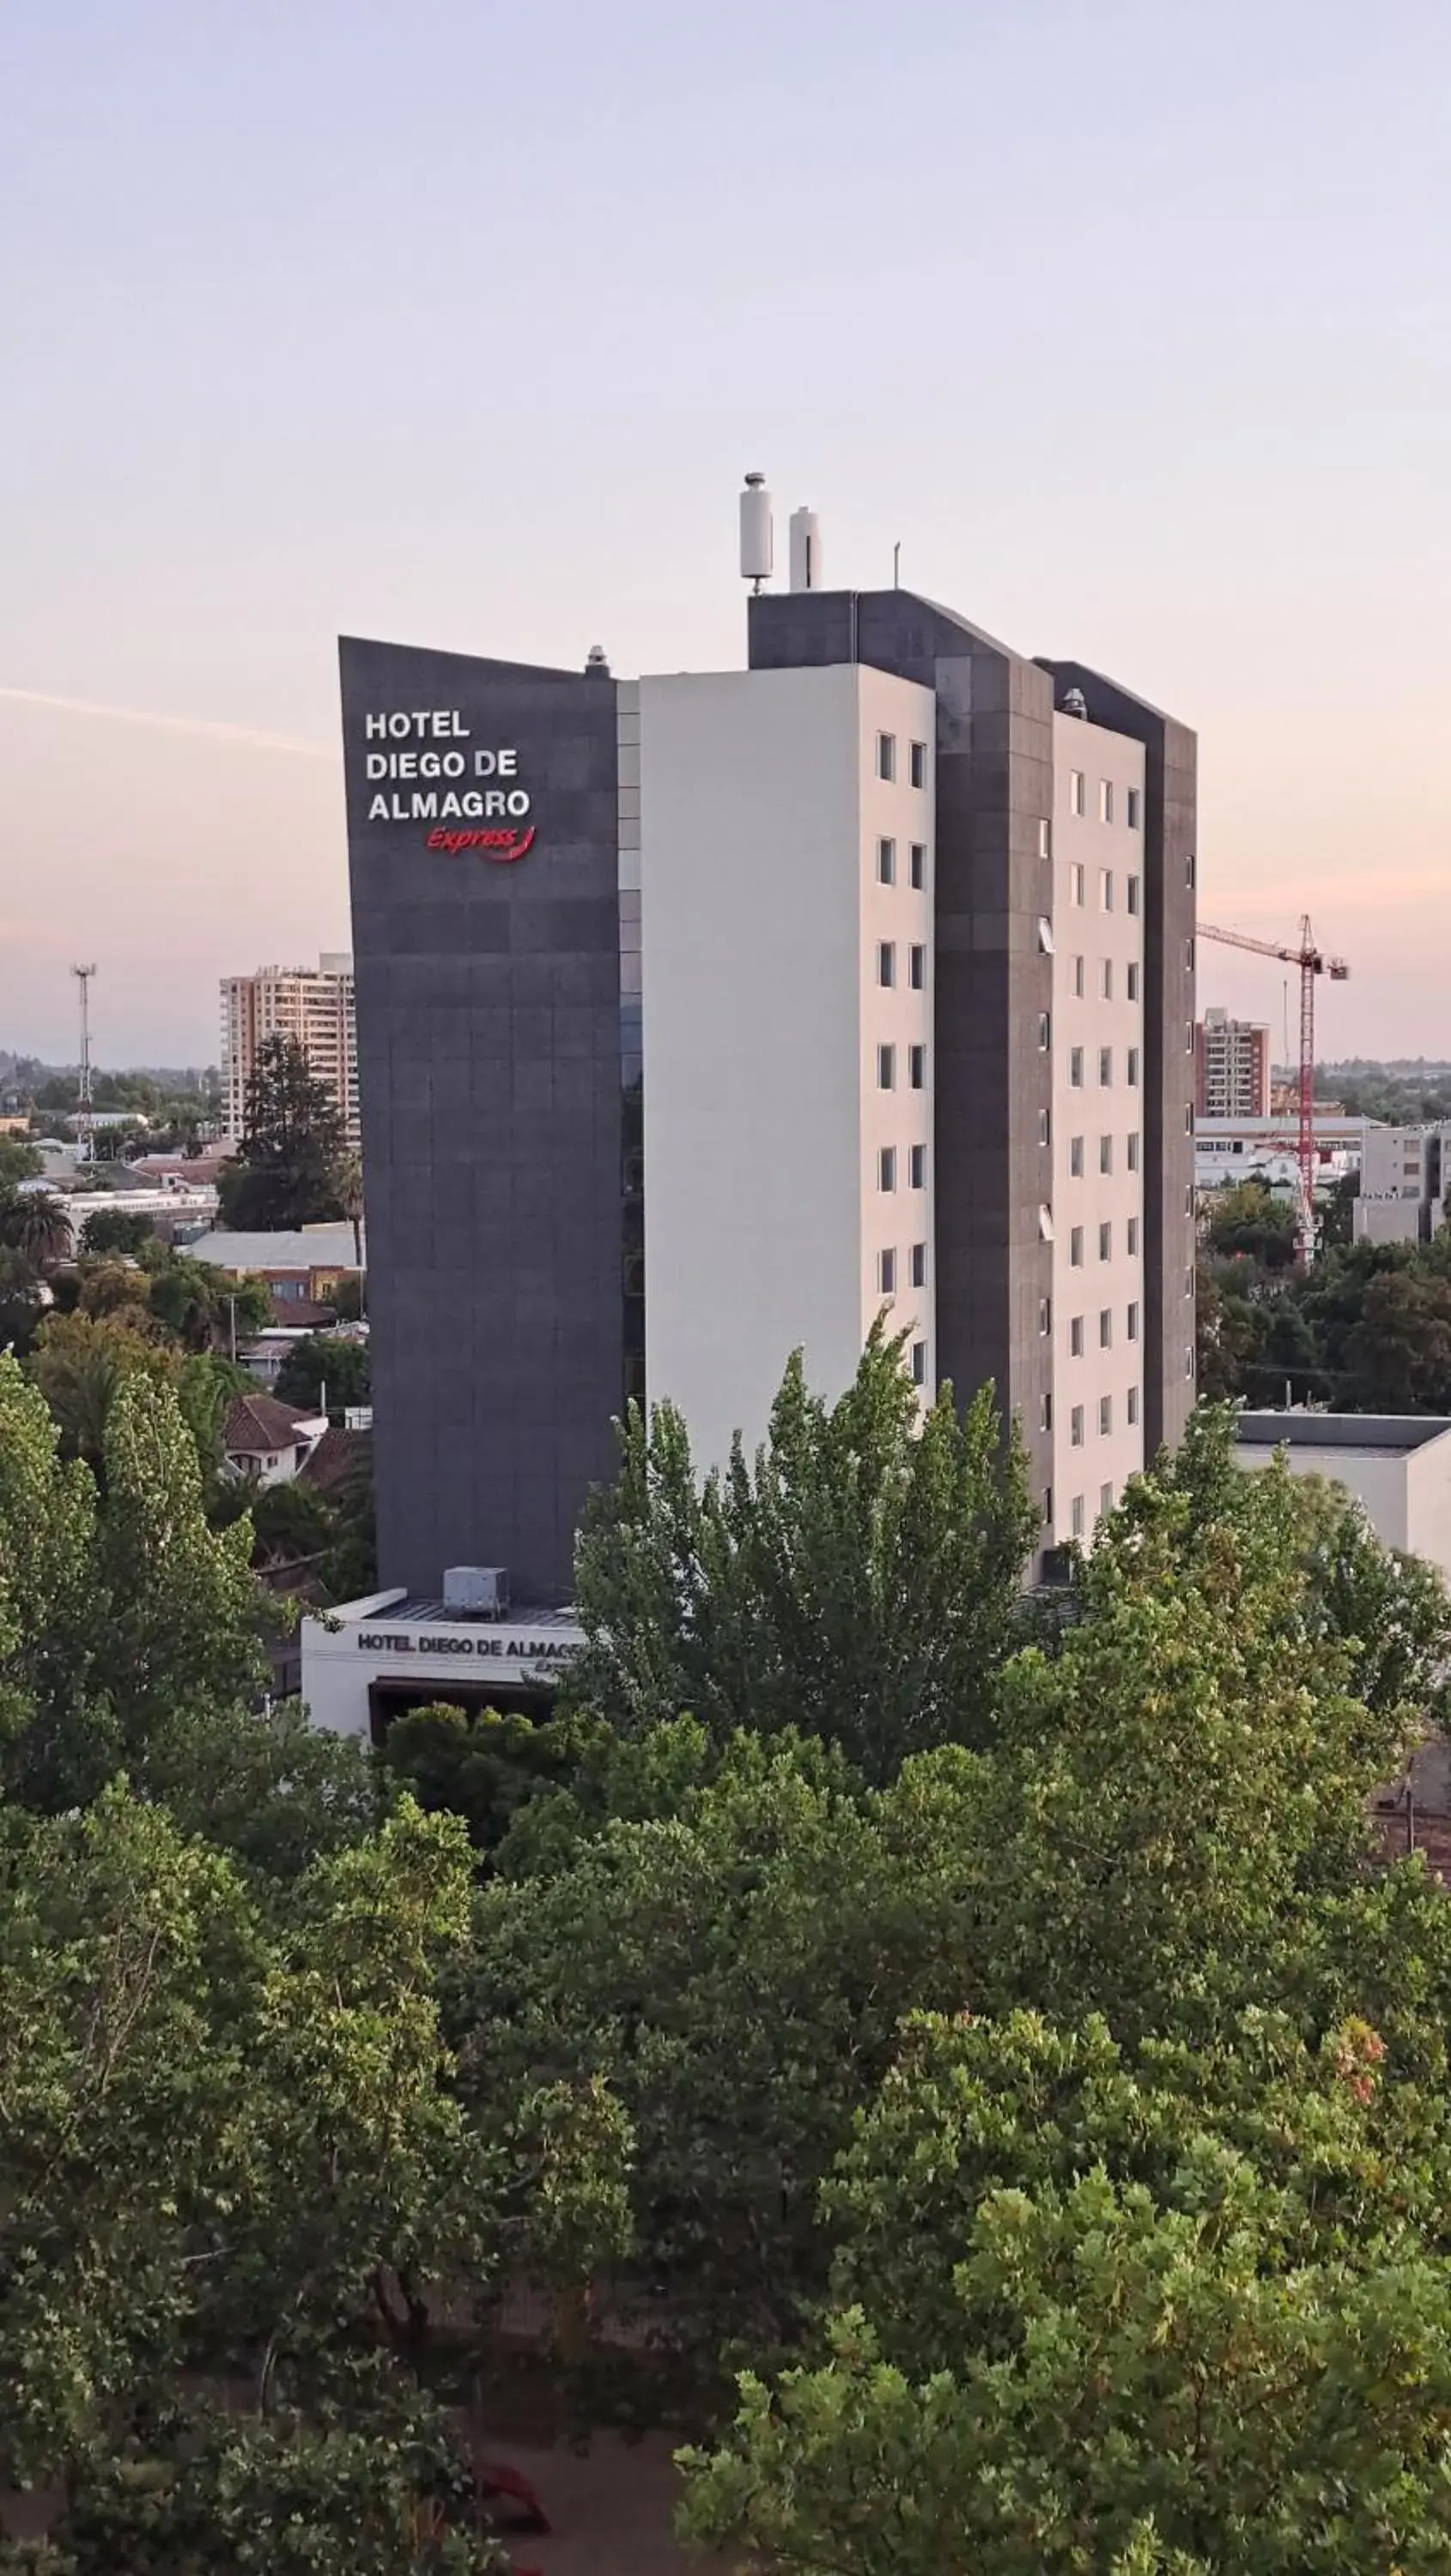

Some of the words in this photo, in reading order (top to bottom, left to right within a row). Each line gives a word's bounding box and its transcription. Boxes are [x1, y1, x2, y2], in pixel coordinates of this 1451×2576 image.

[366, 711, 471, 739] HOTEL
[367, 751, 465, 779] DIEGO
[475, 750, 517, 776] DE
[368, 790, 530, 820] ALMAGRO
[427, 825, 517, 856] Express
[358, 1633, 416, 1652] HOTEL
[419, 1636, 474, 1654] DIEGO
[477, 1639, 502, 1656] DE
